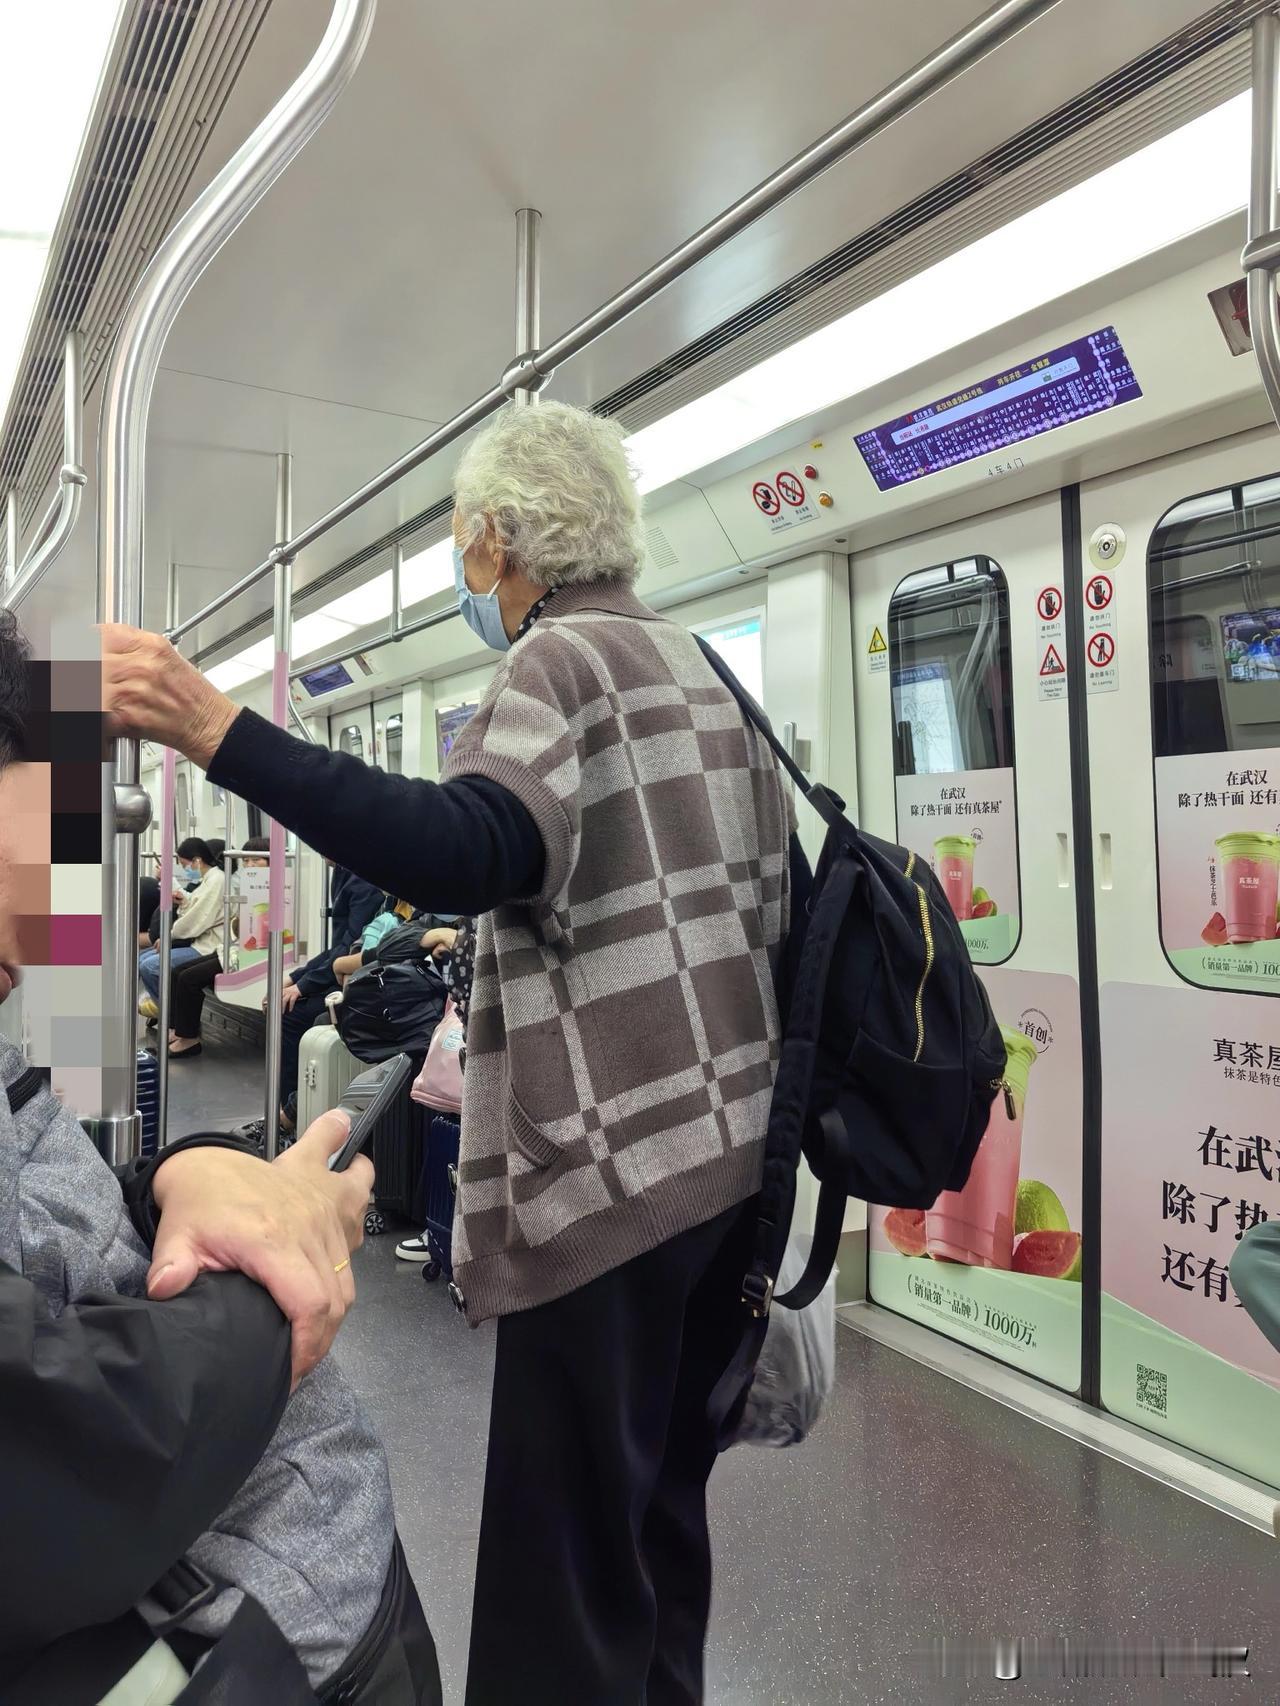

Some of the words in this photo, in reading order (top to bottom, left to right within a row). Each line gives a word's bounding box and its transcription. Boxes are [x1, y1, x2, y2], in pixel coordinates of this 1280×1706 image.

[1226, 769, 1268, 787] 在武汉
[940, 787, 966, 801] 在武汉
[1178, 790, 1244, 808] 除了热干面
[1250, 789, 1280, 805] 还有
[910, 803, 952, 816] 除了热干面
[1025, 1020, 1048, 1045] 首创
[1224, 1066, 1280, 1087] 抹茶是特色
[1197, 1125, 1280, 1183] 在武
[1162, 1180, 1280, 1241] 除了热
[1160, 1243, 1245, 1307] 还有
